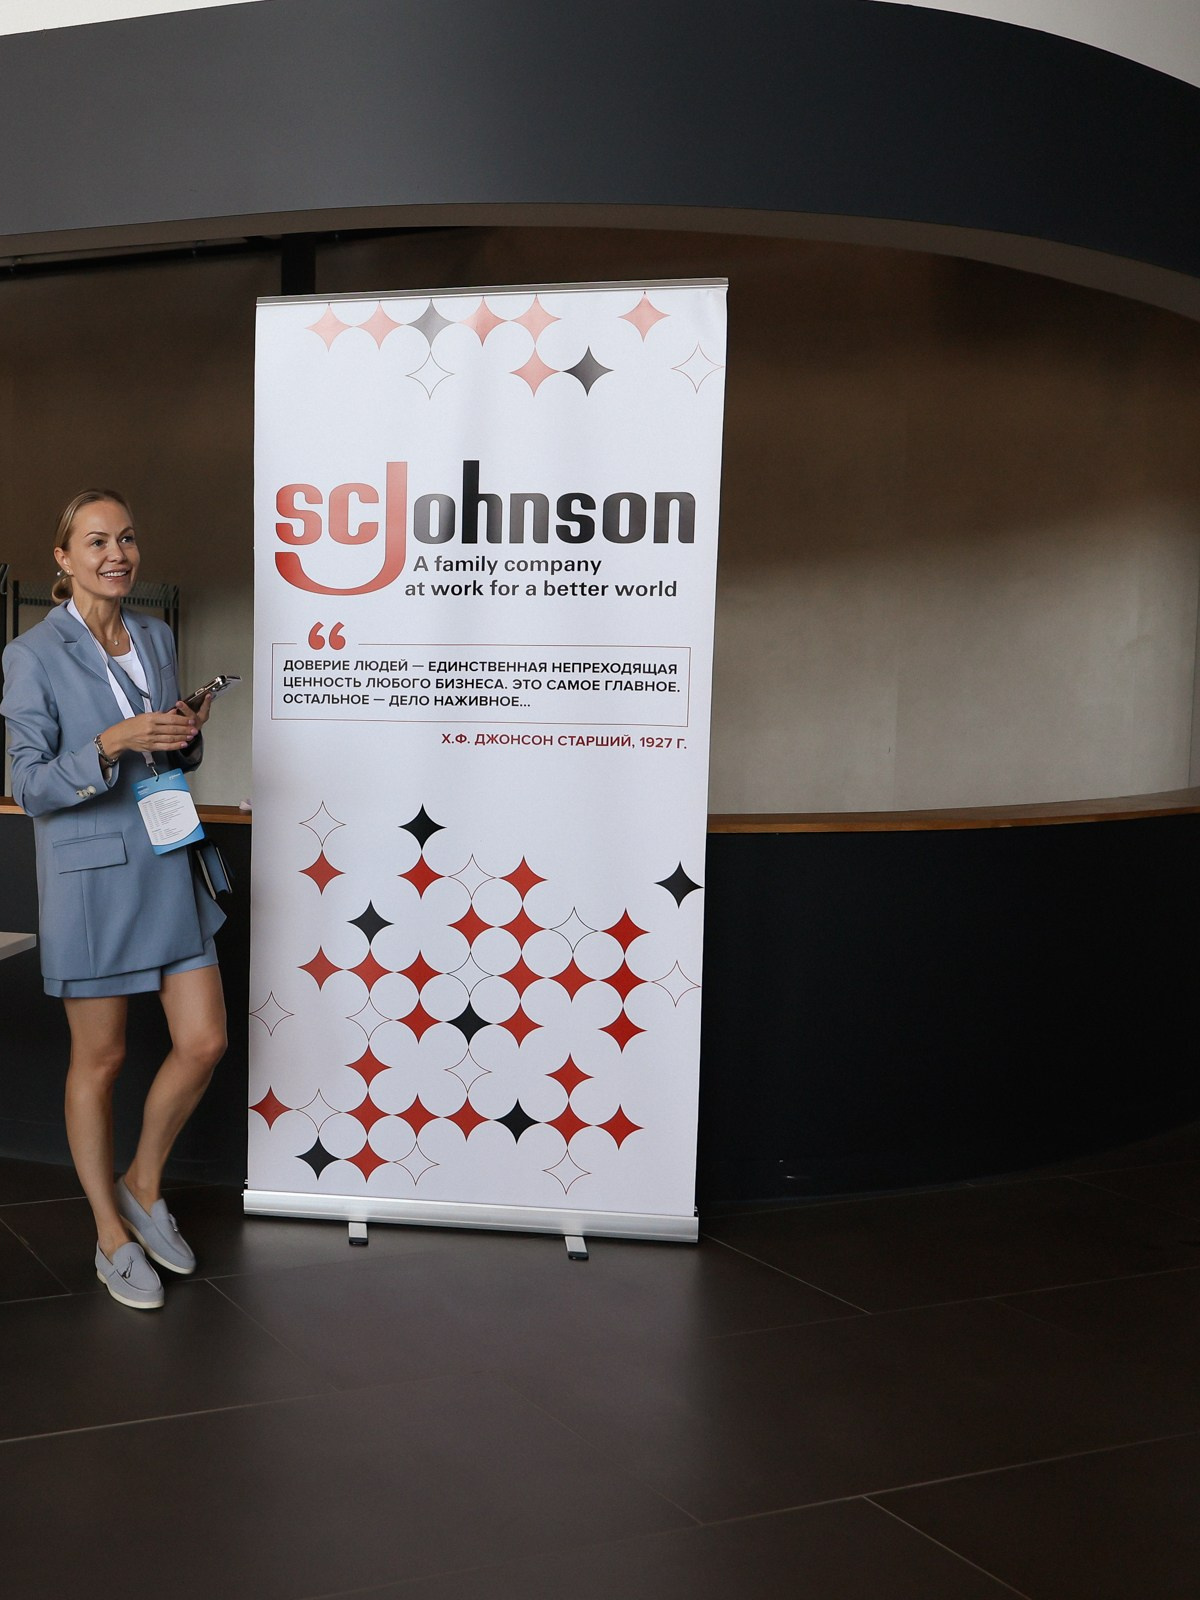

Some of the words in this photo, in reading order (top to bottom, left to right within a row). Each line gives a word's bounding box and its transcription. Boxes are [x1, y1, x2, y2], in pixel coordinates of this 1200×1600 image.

[412, 555, 429, 572] A
[433, 555, 499, 576] family
[503, 559, 603, 576] company
[404, 581, 426, 597] at
[430, 579, 485, 597] work
[489, 579, 520, 597] for
[525, 584, 537, 597] a
[543, 579, 610, 597] better
[614, 580, 678, 598] world
[282, 659, 351, 673] ДОВЕРИЕ
[353, 658, 408, 673] ЛЮДЕЙ
[428, 660, 548, 674] ЕДИНСТВЕННАЯ
[551, 661, 678, 676] НЕПРЕХОДЯЩАЯ
[283, 676, 362, 689] ЦЕННОСТЬ
[365, 677, 432, 690] ЛЮБОГО
[435, 678, 508, 690] БИЗНЕСА.
[512, 678, 543, 691] ЭТО
[546, 679, 601, 691] САМОЕ
[604, 679, 681, 693] ГЛАВНОЕ.
[282, 692, 370, 705] ОСТАЛЬНОЕ
[388, 694, 430, 708] ДЕЛО
[433, 695, 531, 708] НАЖИВНОЕ...
[441, 733, 471, 745] Х.Ф.
[474, 733, 554, 746] ДЖОНСОН
[557, 734, 636, 749] СТАРШИЙ,
[639, 736, 673, 749] 1927
[676, 738, 687, 750] Г.
